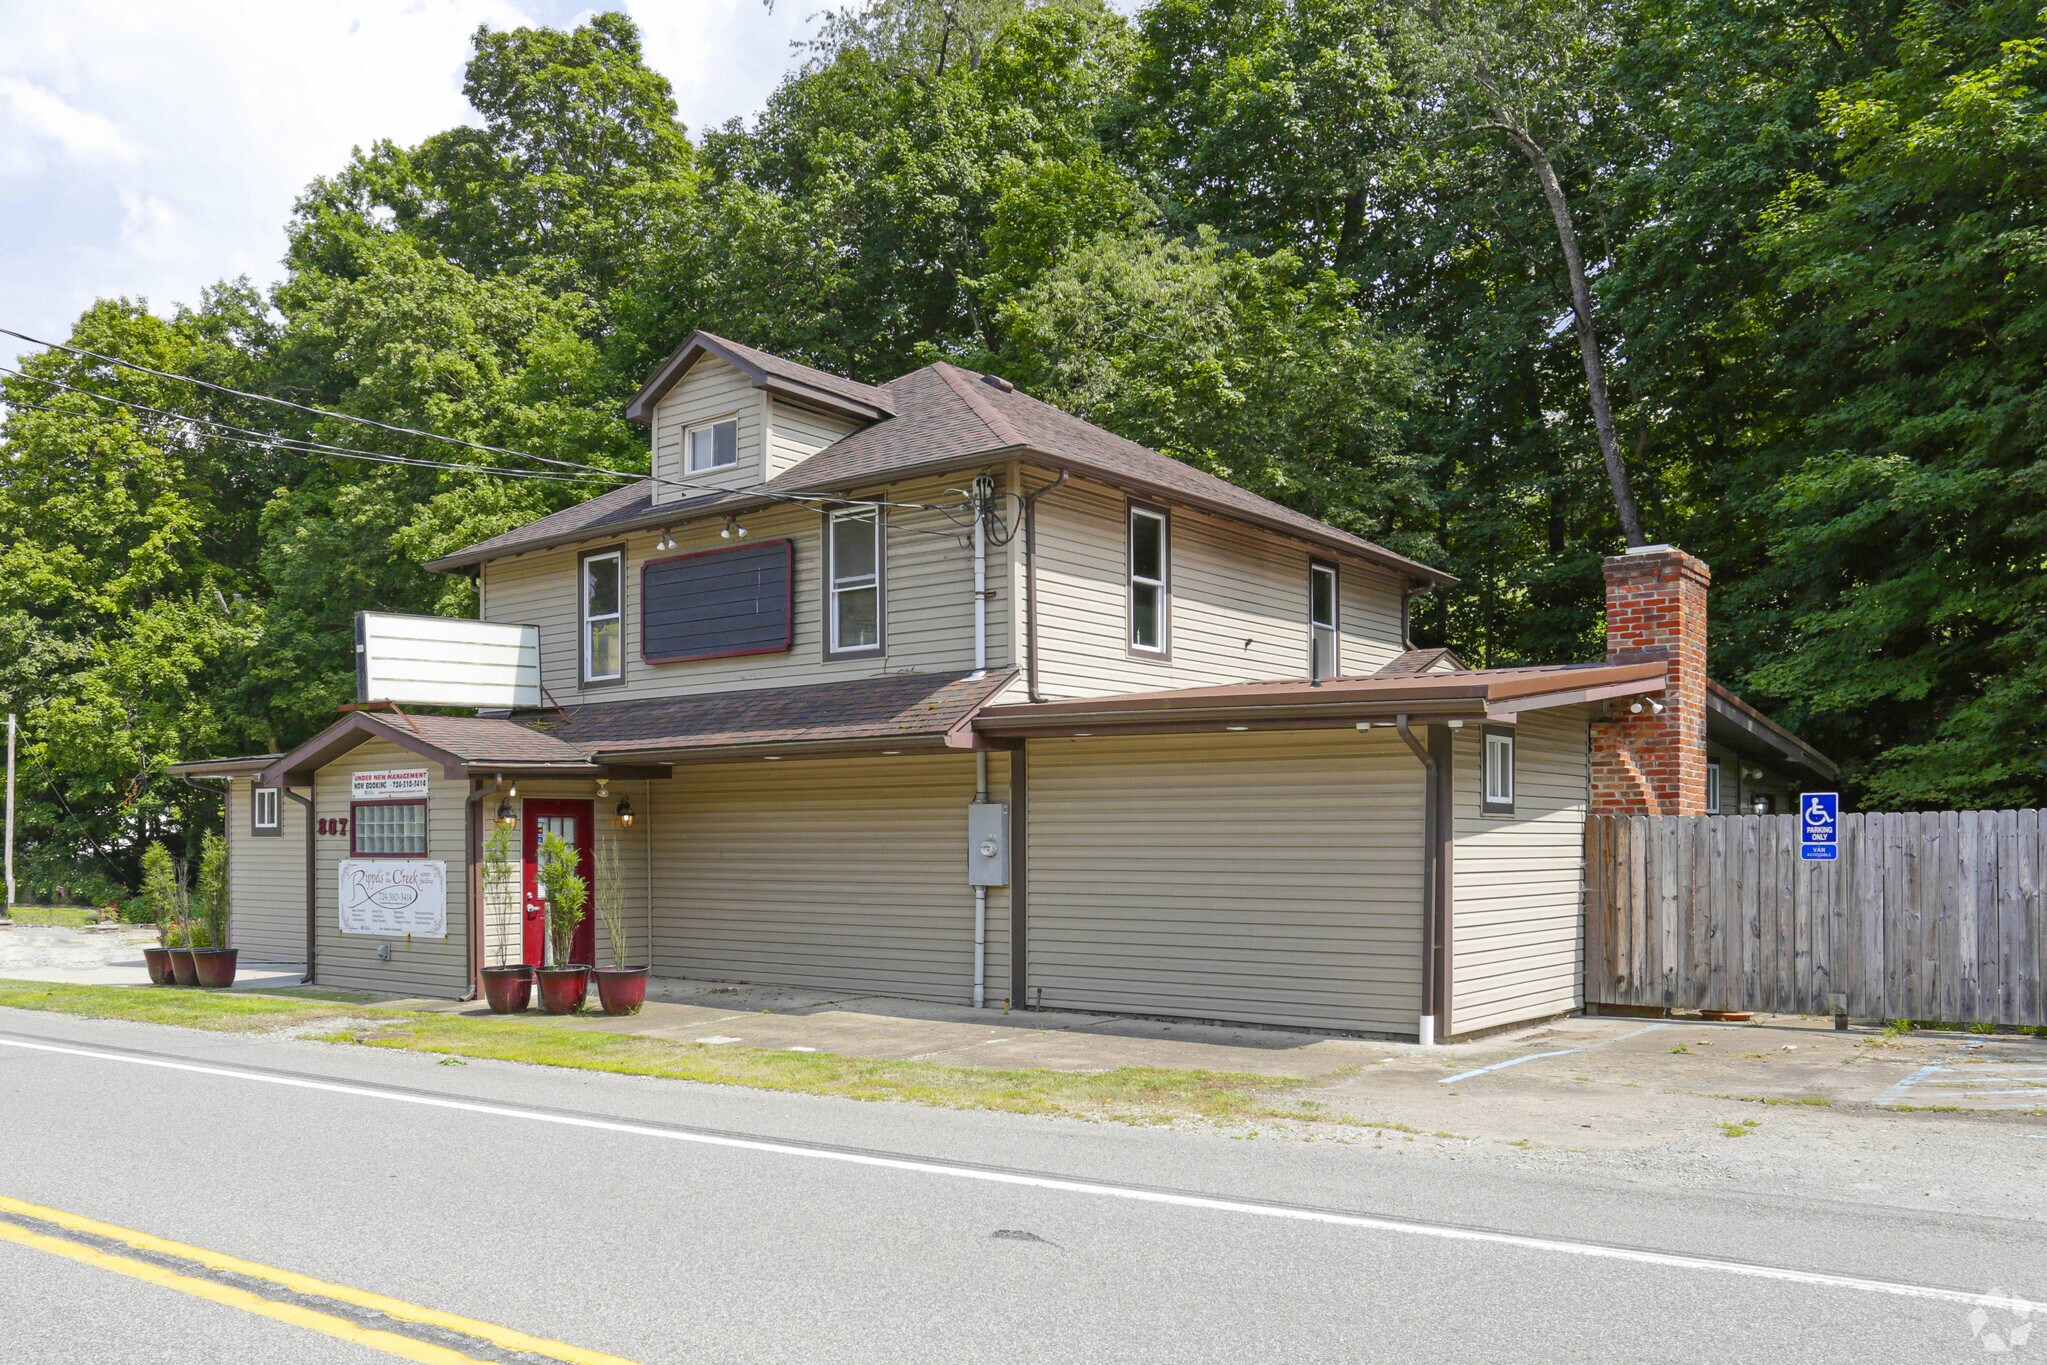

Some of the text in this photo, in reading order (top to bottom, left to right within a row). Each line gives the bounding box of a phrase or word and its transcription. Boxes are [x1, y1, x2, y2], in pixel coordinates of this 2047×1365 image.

[387, 772, 427, 780] MANAGEMENT
[365, 781, 387, 789] BOOKING
[318, 817, 348, 836] 807
[392, 869, 423, 892] Creek
